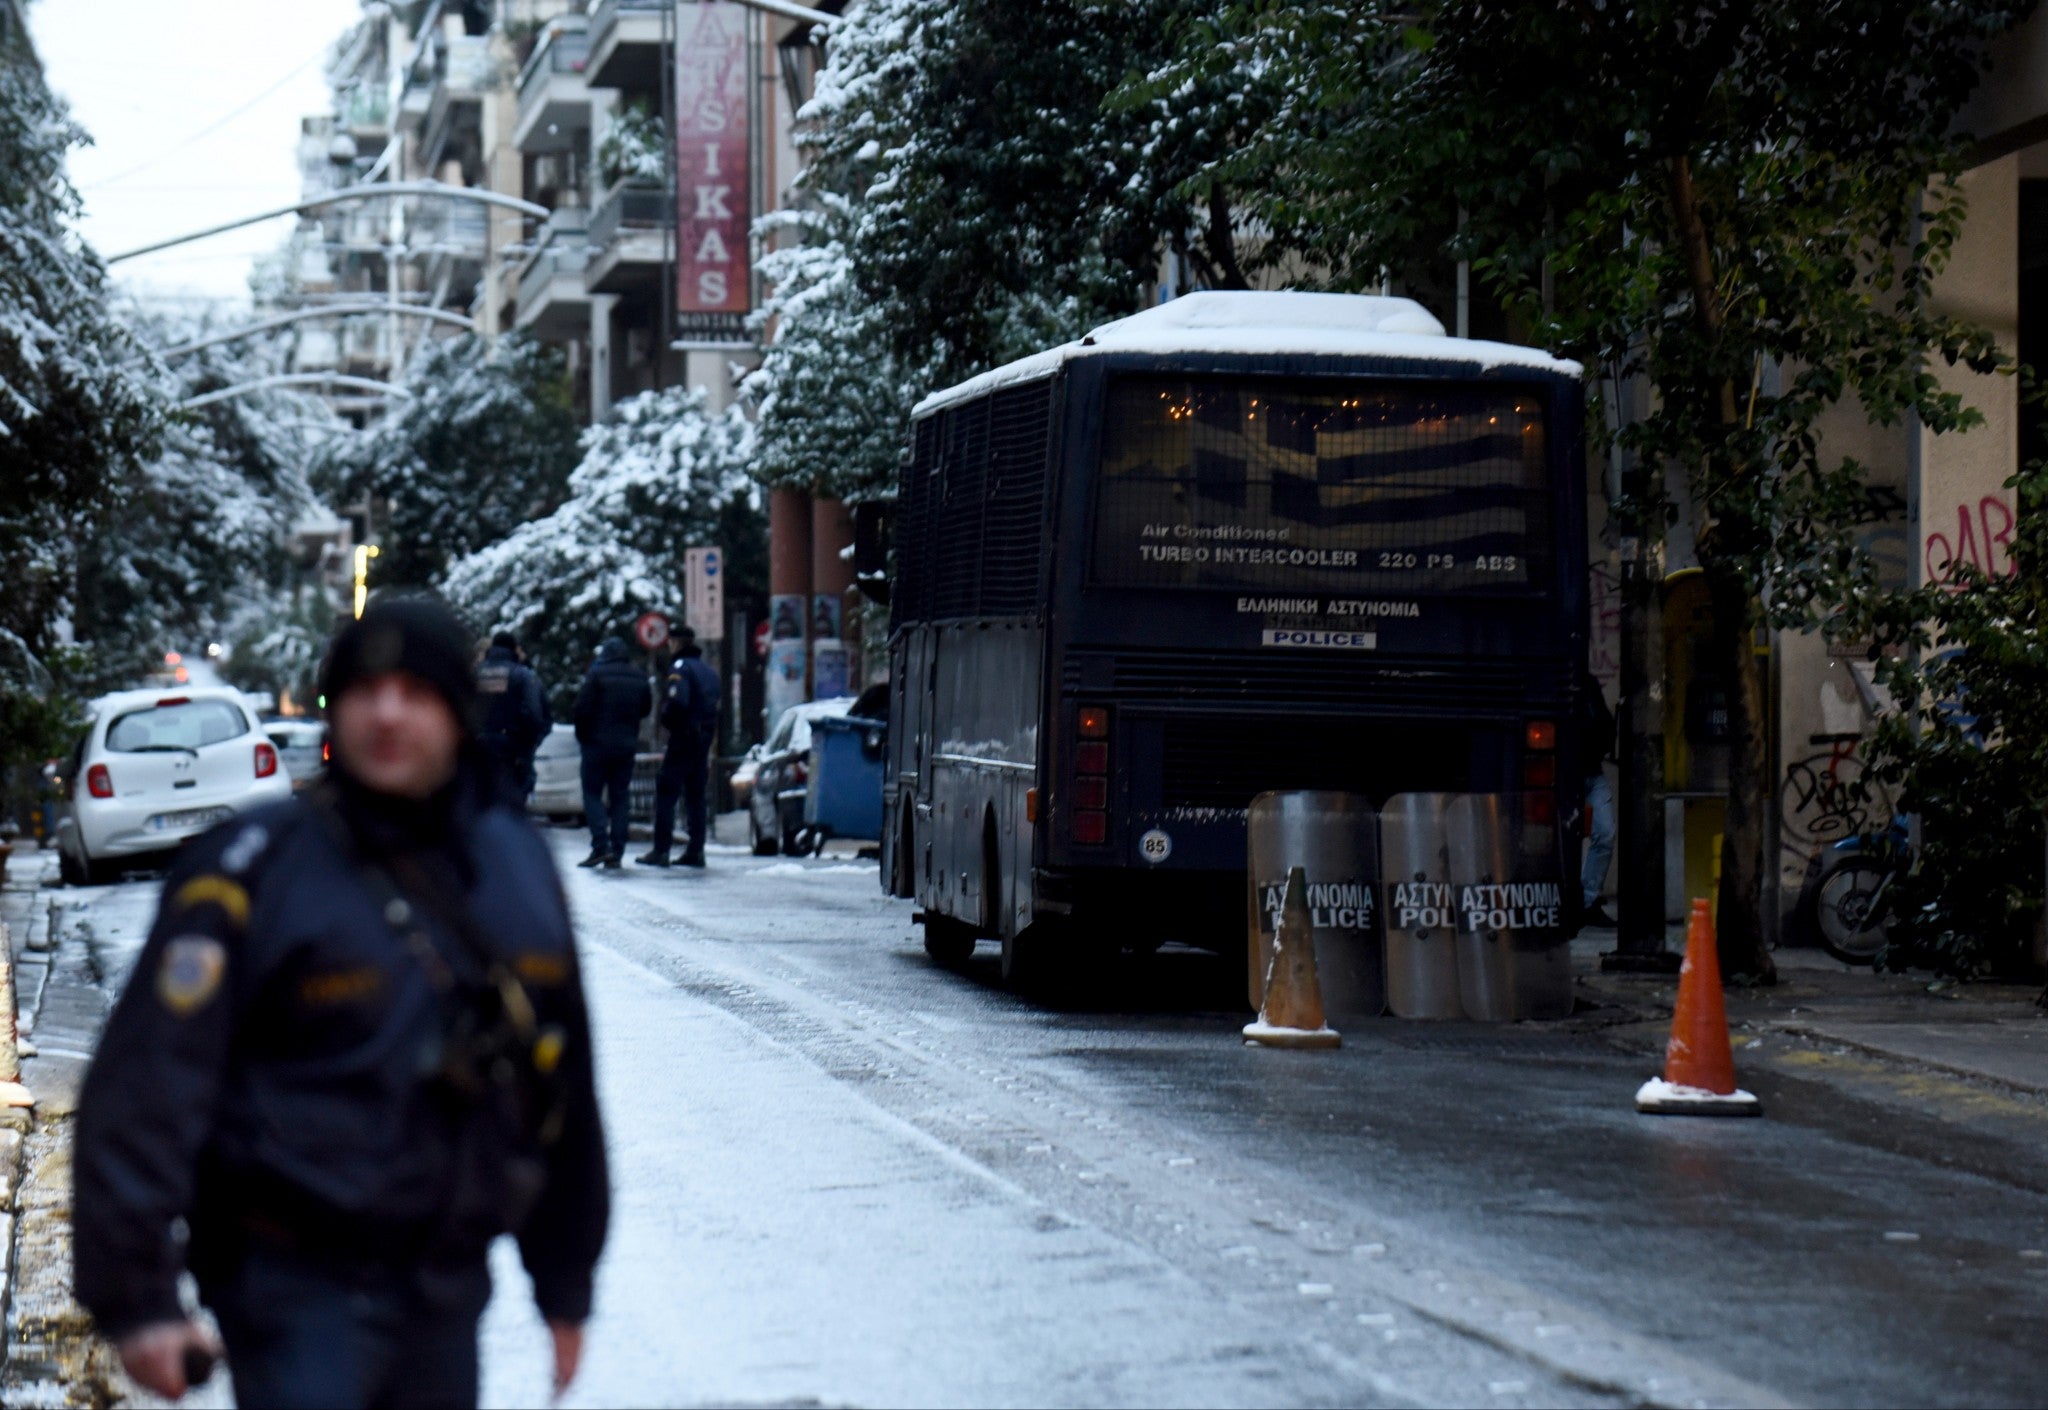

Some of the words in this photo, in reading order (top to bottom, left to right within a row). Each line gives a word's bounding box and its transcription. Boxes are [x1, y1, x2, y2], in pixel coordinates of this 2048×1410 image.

[1141, 523, 1169, 538] Air
[1174, 524, 1290, 541] Conditioned
[1139, 545, 1209, 562] TURBO
[1214, 546, 1358, 566] INTERCOOLER
[1378, 552, 1417, 569] 220
[1427, 554, 1454, 569] PS
[1475, 555, 1517, 571] ABS
[1236, 597, 1320, 614] ΕΛΛΗΝΙΚΗ
[1326, 600, 1420, 618] ΑΣΤΥΝΟΜΙΑ
[1274, 631, 1366, 647] POLICE
[1146, 839, 1165, 853] 85
[1265, 882, 1374, 911] ΑΥΝΟΜΙΑ
[1461, 881, 1562, 912] ΑΣΤΥΝΟΜΙΑ
[1272, 907, 1371, 929] LICE
[1468, 907, 1561, 932] POLICE
